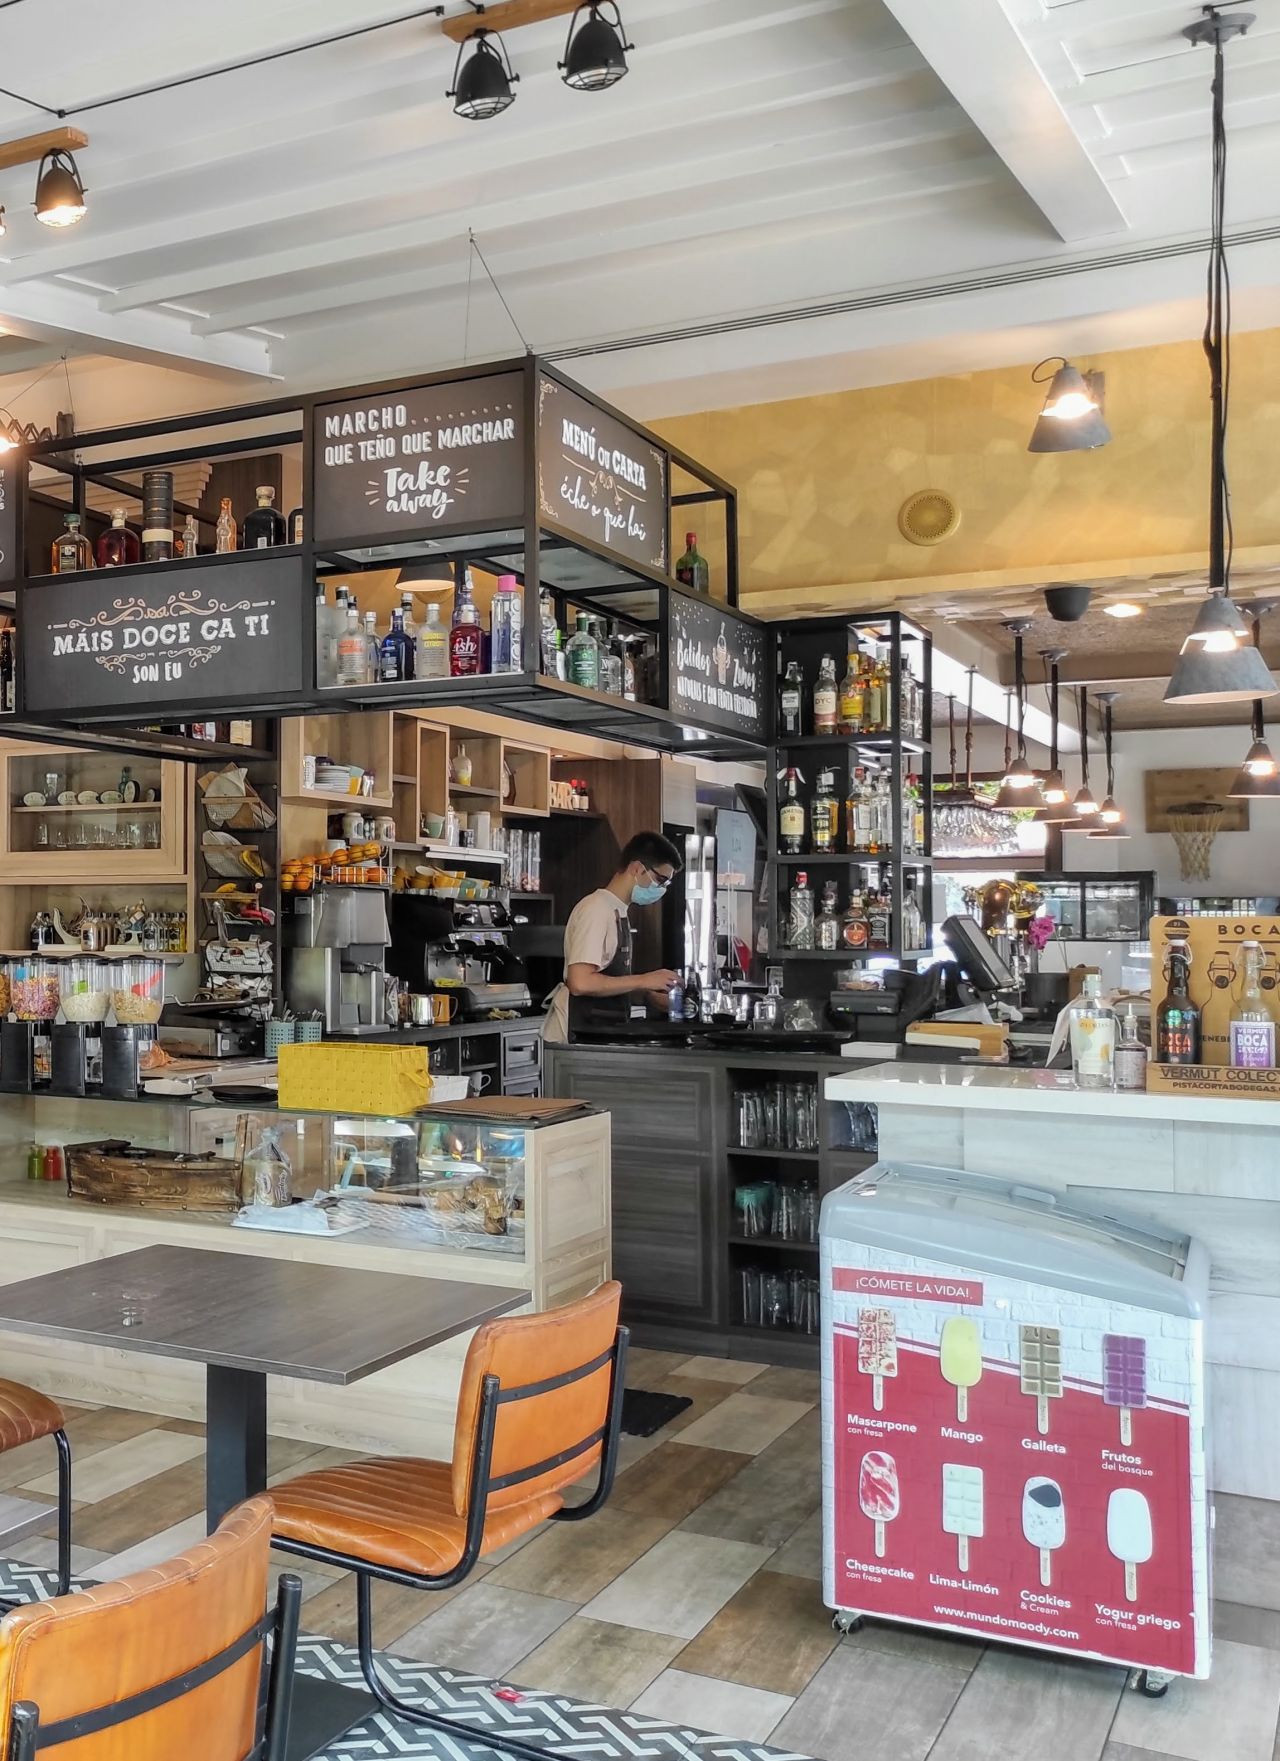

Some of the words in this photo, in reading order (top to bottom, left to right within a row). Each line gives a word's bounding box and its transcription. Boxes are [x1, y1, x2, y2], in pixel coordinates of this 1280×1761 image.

[324, 444, 354, 467] QUE
[358, 434, 396, 462] TEÑO
[402, 432, 432, 455] QUE
[438, 418, 515, 450] MARCHAR
[562, 418, 596, 461] MENÚ
[612, 450, 646, 490] CARTA
[384, 460, 451, 498] Take
[386, 488, 454, 519] away
[52, 628, 114, 656] MÁIS
[122, 621, 191, 649] DOCE
[200, 617, 236, 641] CA
[244, 614, 270, 637] TI
[132, 662, 159, 684] SON
[164, 661, 182, 682] EU
[549, 780, 573, 810] BAR
[1218, 924, 1280, 935] BOCA
[1238, 1034, 1268, 1046] BOCA
[1160, 1067, 1220, 1080] VERMUT
[1226, 1070, 1280, 1082] COLEC
[916, 1282, 932, 1294] LA
[847, 1414, 918, 1433] Mascarpone
[847, 1426, 862, 1435] con
[864, 1427, 884, 1438] fresa
[940, 1426, 984, 1444] Mango
[1022, 1438, 1066, 1454] Galleta
[1102, 1450, 1142, 1464] Frutos
[1102, 1462, 1116, 1471] del
[1118, 1464, 1154, 1476] bosque
[846, 1558, 914, 1580] Cheesecake
[846, 1572, 860, 1580] con
[862, 1572, 882, 1583] fresa
[929, 1574, 1000, 1596] Lima-Limón
[1020, 1590, 1072, 1608] Cookies
[1020, 1602, 1028, 1610] &
[1030, 1604, 1059, 1616] Cream
[1094, 1603, 1134, 1620] Yogur
[1137, 1614, 1182, 1630] griego
[934, 1605, 1080, 1640] www.mundomoody.com
[1095, 1617, 1112, 1626] con
[1114, 1619, 1137, 1631] fresa
